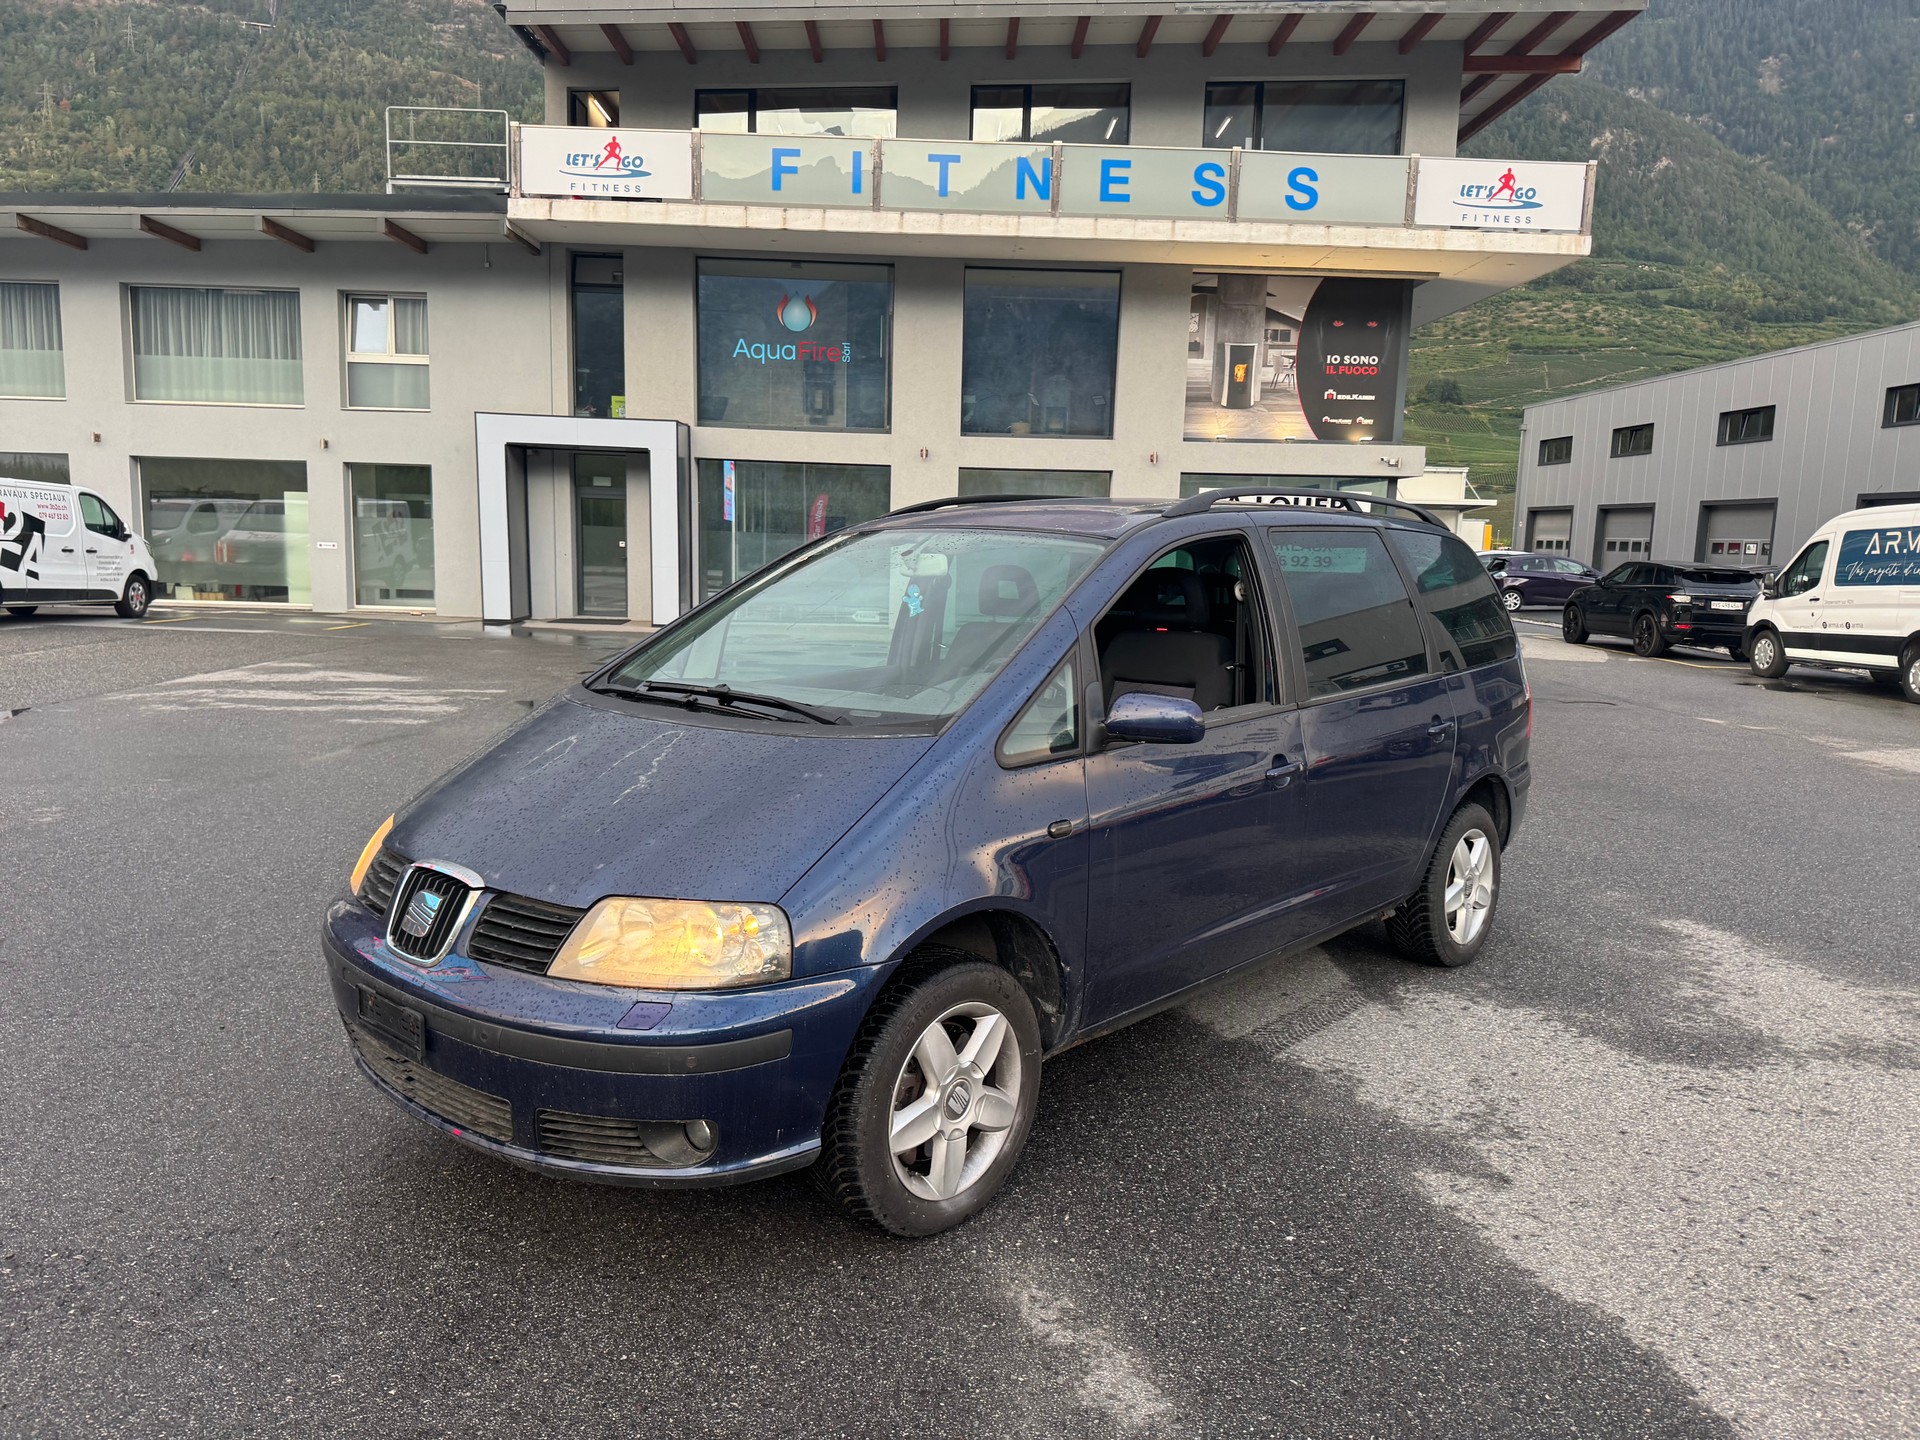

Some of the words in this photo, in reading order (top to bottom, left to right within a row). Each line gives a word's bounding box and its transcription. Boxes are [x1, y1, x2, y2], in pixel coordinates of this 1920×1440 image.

[566, 153, 601, 167] LET'S
[621, 155, 644, 168] GO
[771, 147, 1320, 211] FITNESS
[570, 182, 641, 193] FITNESS
[1459, 184, 1495, 198] LET'S
[1514, 187, 1536, 200] GO
[1462, 213, 1532, 224] FITNESS
[732, 338, 841, 365] AquaFire
[1326, 354, 1341, 364] IO
[1343, 355, 1379, 365] SONO
[1326, 365, 1336, 375] IL
[1338, 366, 1378, 375] FUOCO
[1291, 555, 1310, 567] 92
[1312, 555, 1333, 568] 39
